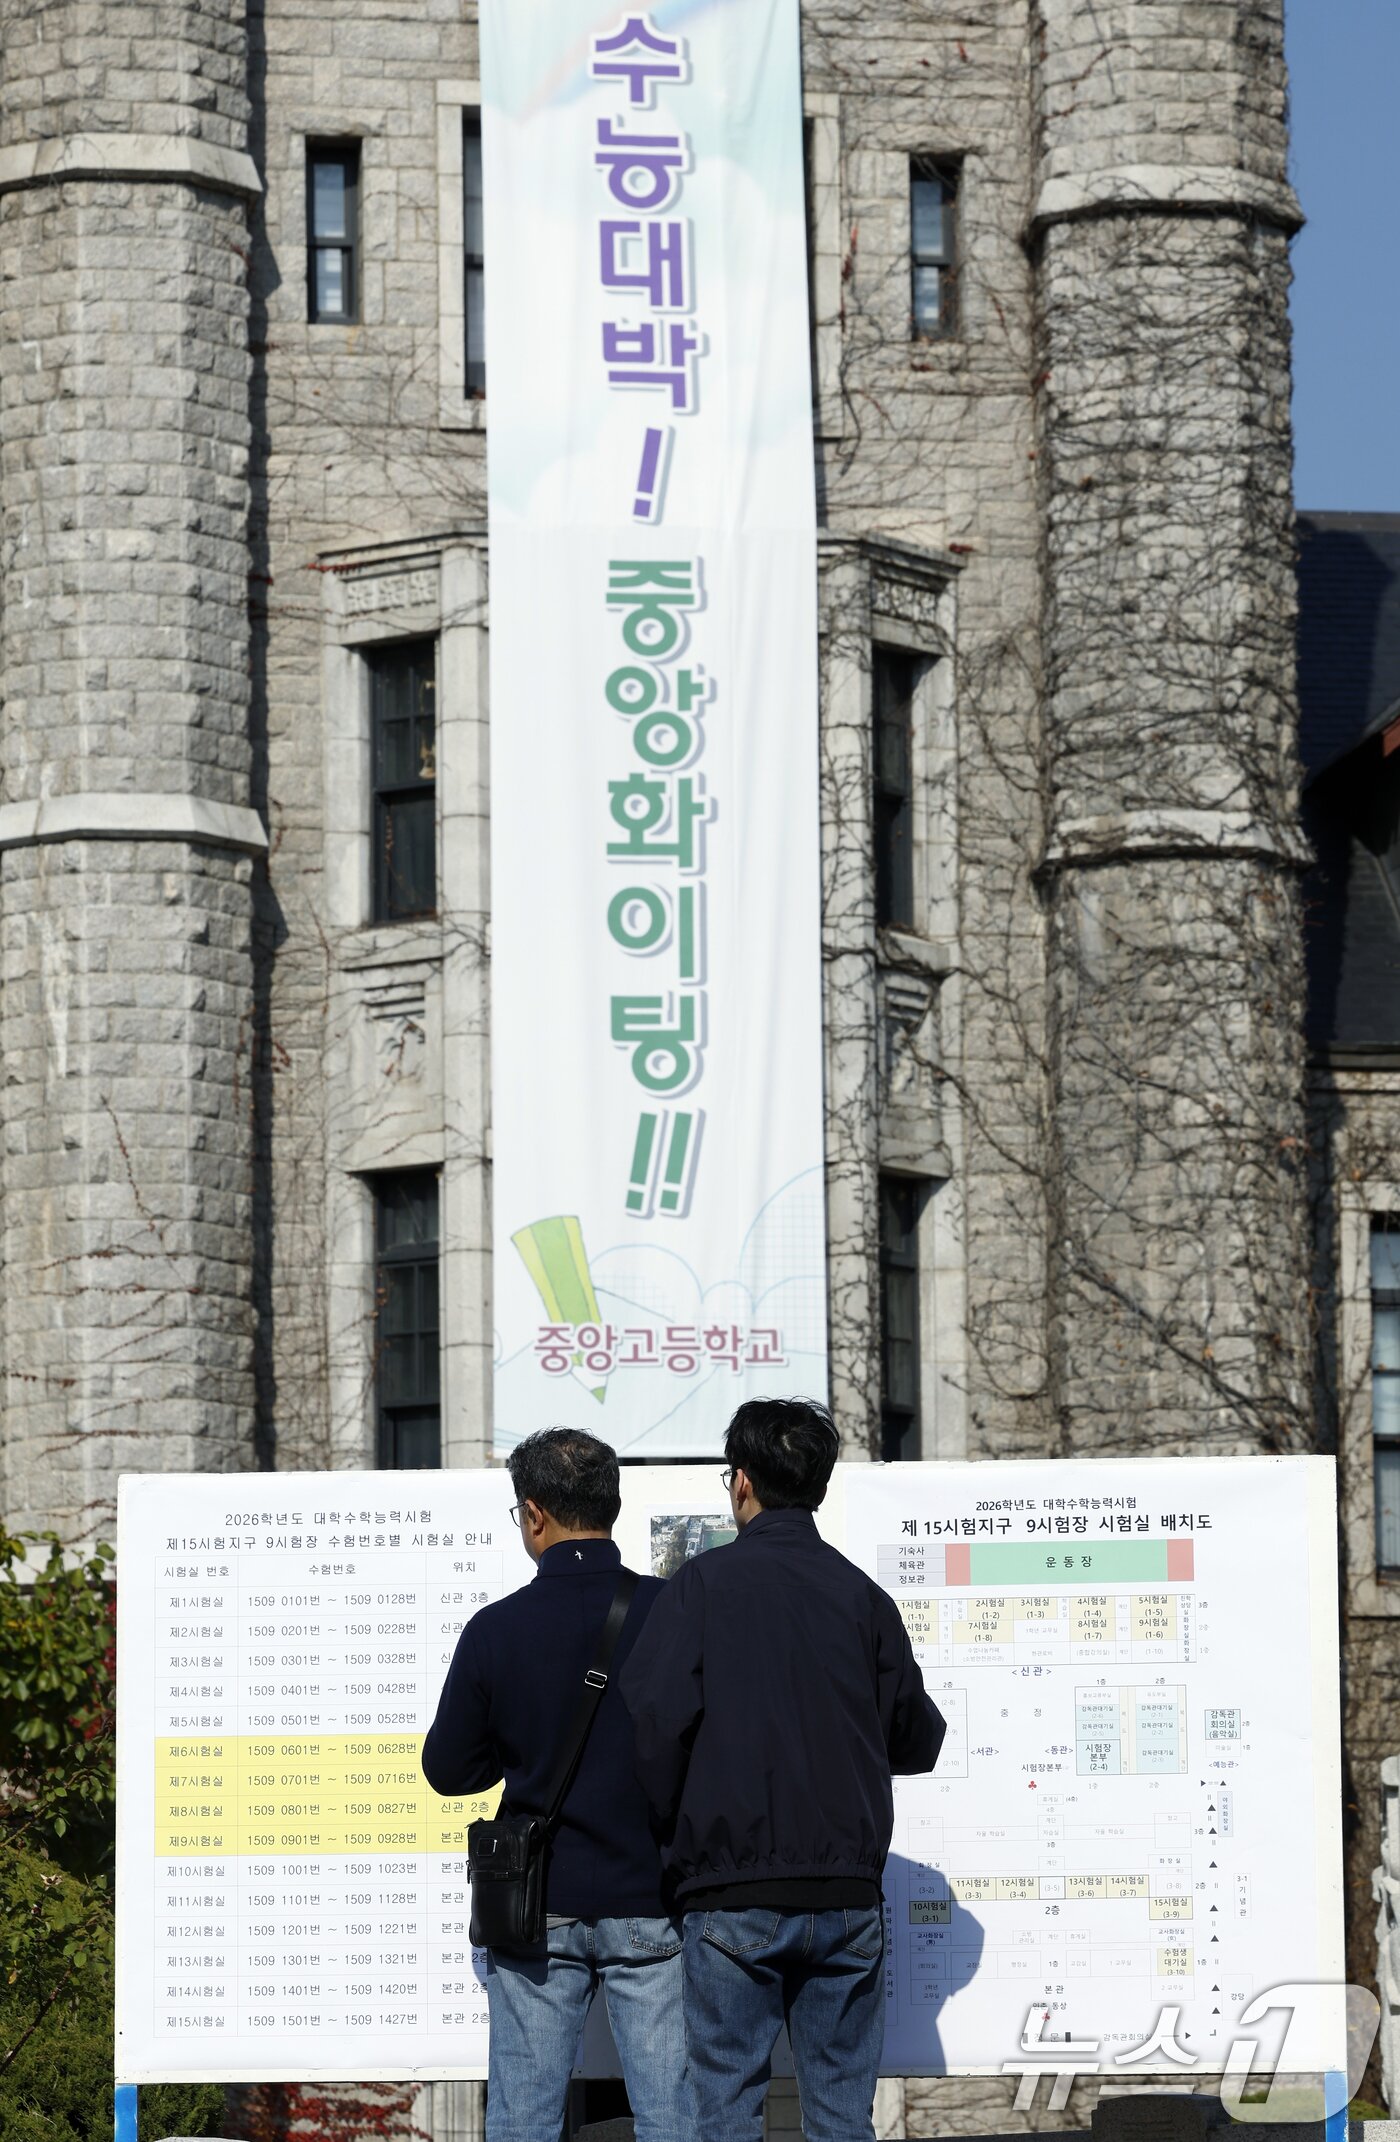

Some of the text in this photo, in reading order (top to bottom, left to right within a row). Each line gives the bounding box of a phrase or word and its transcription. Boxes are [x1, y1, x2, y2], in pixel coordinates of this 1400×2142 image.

[592, 17, 700, 519] 수능대박!
[534, 1323, 785, 1373] 중앙고등학교
[975, 1496, 1137, 1512] 2026학년도 대학수학능력시험
[225, 1509, 432, 1527] 2026학년도 대학수학능력시험
[900, 1513, 1213, 1537] 제 15시험지구 9시험장 시험실 배치도
[165, 1532, 492, 1551] 제15시험지구 9시험장 수험번호별 시험실 안내
[898, 1546, 925, 1557] 기숙사
[163, 1565, 230, 1578] 시험실 번호
[308, 1563, 356, 1576] 수험번호
[452, 1561, 476, 1573] 위치
[898, 1560, 926, 1571] 체육관
[898, 1574, 926, 1585] 정보관
[169, 1596, 224, 1609] 제1시험실
[248, 1594, 320, 1607] 1509 0101번
[344, 1592, 416, 1606] 1509 0128번
[440, 1591, 489, 1604] 신관 3층
[975, 1599, 1005, 1608] 2시험실
[1020, 1598, 1050, 1607] 3시험실
[1077, 1597, 1107, 1606] 4시험실
[1138, 1595, 1168, 1605] 5시험실
[901, 1600, 930, 1609] 1시험실
[908, 1613, 925, 1621] (1-1)
[981, 1611, 1000, 1620] (1-2)
[1026, 1611, 1045, 1619] (1-3)
[1083, 1609, 1102, 1618] (1-4)
[1144, 1608, 1163, 1617] (1-5)
[440, 1622, 464, 1635] 신관
[968, 1621, 998, 1631] 7시험실
[1078, 1619, 1107, 1628] 8시험실
[1139, 1618, 1169, 1627] 9시험실
[169, 1626, 224, 1638] 제2시험실
[248, 1624, 321, 1637] 1509 0201번
[344, 1623, 416, 1636] 1509 0228번
[1084, 1632, 1102, 1640] (1-7)
[1145, 1631, 1164, 1639] (1-6)
[974, 1634, 993, 1642] (1-8)
[169, 1655, 223, 1668] 제3시험실
[248, 1654, 320, 1667] 1509 0301번
[344, 1652, 417, 1665] 1509 0328번
[169, 1685, 223, 1698] 제4시험실
[248, 1684, 320, 1697] 1509 0401번
[344, 1682, 417, 1695] 1509 0428번
[248, 1713, 320, 1726] 1509 0501번
[344, 1712, 417, 1725] 1509 0528번
[1210, 1710, 1235, 1719] 감독관
[169, 1715, 223, 1728] 제5시험실
[1210, 1719, 1235, 1729] 회의실
[1209, 1730, 1238, 1739] (음악실)
[168, 1745, 223, 1758] 제6시험실
[248, 1743, 320, 1757] 1509 0601번
[344, 1742, 417, 1755] 1509 0628번
[1085, 1743, 1112, 1753] 시험장
[1090, 1753, 1107, 1762] 본부
[1089, 1763, 1108, 1772] (2-4)
[168, 1775, 223, 1788] 제7시험실
[247, 1773, 320, 1786] 1509 0701번
[344, 1772, 417, 1785] 1509 0716번
[168, 1805, 223, 1817] 제8시험실
[247, 1803, 320, 1816] 1509 0801번
[344, 1802, 417, 1815] 1509 0827번
[440, 1801, 490, 1814] 신관 2층
[168, 1835, 223, 1848] 제9시험실
[247, 1833, 321, 1846] 1509 0901번
[344, 1832, 417, 1845] 1509 0928번
[440, 1831, 465, 1844] 본관
[166, 1865, 225, 1878] 제10시험실
[247, 1863, 320, 1876] 1509 1001번
[344, 1862, 417, 1875] 1509 1023번
[440, 1861, 465, 1874] 본관
[956, 1879, 990, 1888] 11시험실
[1001, 1878, 1035, 1887] 12시험실
[1069, 1876, 1103, 1886] 13시험실
[1111, 1875, 1145, 1885] 14시험실
[344, 1892, 417, 1905] 1509 1128번
[440, 1892, 465, 1904] 본관
[965, 1892, 982, 1900] (3-3)
[1009, 1891, 1027, 1899] (3-4)
[1077, 1889, 1095, 1897] (3-6)
[1119, 1888, 1137, 1897] (3-7)
[166, 1895, 225, 1908] 제11시험실
[248, 1894, 321, 1906] 1509 1101번
[913, 1902, 947, 1911] 10시험실
[1154, 1898, 1188, 1907] 15시험실
[1044, 1904, 1061, 1916] 2층
[1163, 1910, 1180, 1919] (3-9)
[922, 1914, 939, 1923] (3-1)
[166, 1925, 225, 1938] 제12시험실
[248, 1924, 321, 1937] 1509 1201번
[344, 1922, 417, 1935] 1509 1221번
[441, 1922, 465, 1934] 본관
[166, 1955, 225, 1968] 제13시험실
[248, 1954, 321, 1967] 1509 1301번
[345, 1952, 417, 1966] 1509 1321번
[441, 1952, 465, 1964] 본관
[166, 1985, 225, 1998] 제14시험실
[248, 1984, 321, 1997] 1509 1401번
[345, 1983, 418, 1996] 1509 1420번
[441, 1982, 465, 1995] 본관
[166, 2015, 225, 2028] 제15시험실
[247, 2014, 321, 2027] 1509 1501번
[344, 2013, 418, 2026] 1509 1427번
[441, 2012, 465, 2025] 본관
